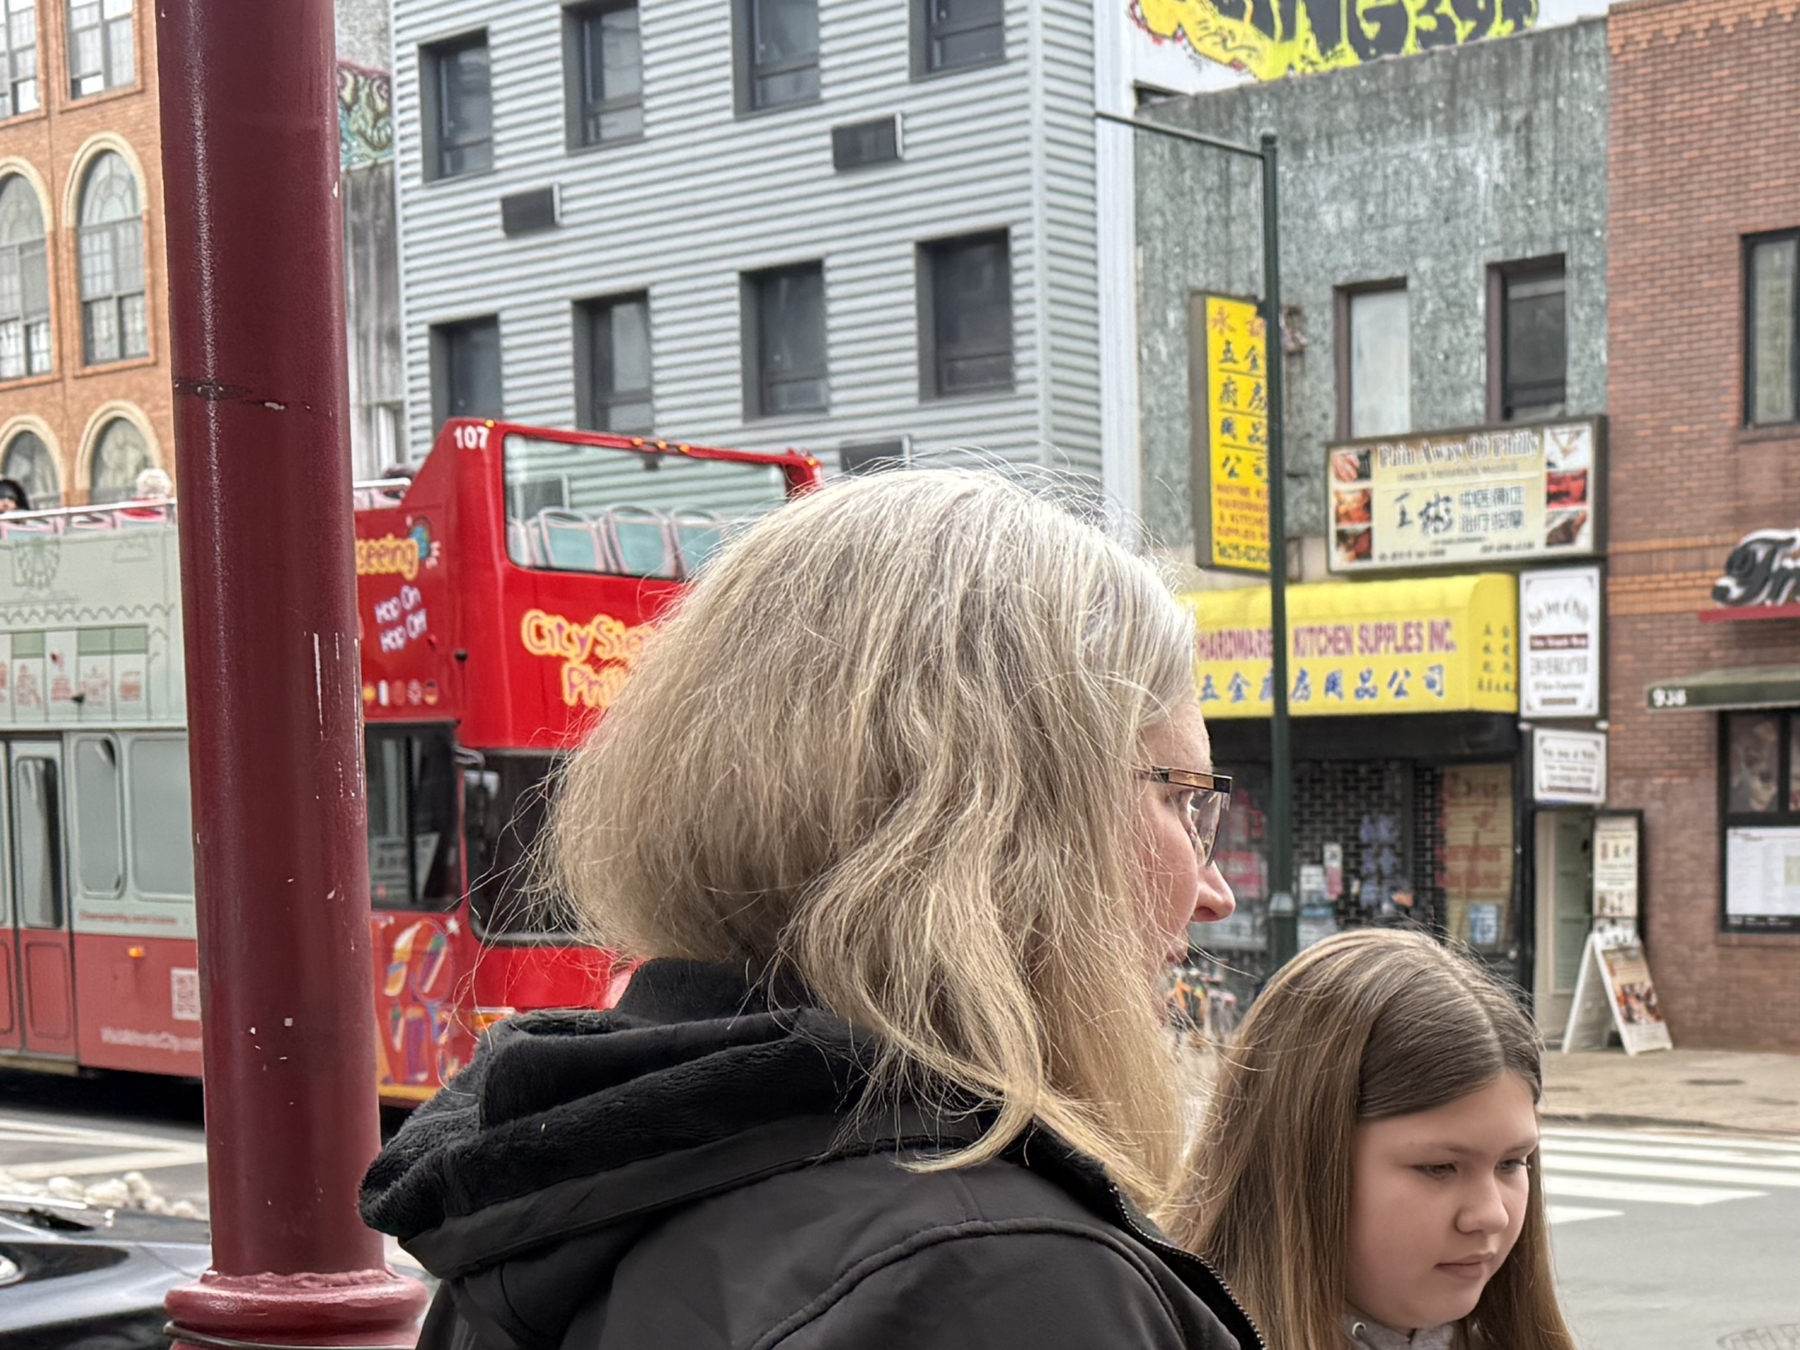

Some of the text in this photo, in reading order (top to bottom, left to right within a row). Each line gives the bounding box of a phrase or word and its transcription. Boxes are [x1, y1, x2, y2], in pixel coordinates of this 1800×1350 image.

[453, 425, 490, 450] 107
[1293, 624, 1353, 658] KITCHEN
[1359, 619, 1424, 656] SUPPLIES
[1429, 617, 1457, 653] INC.
